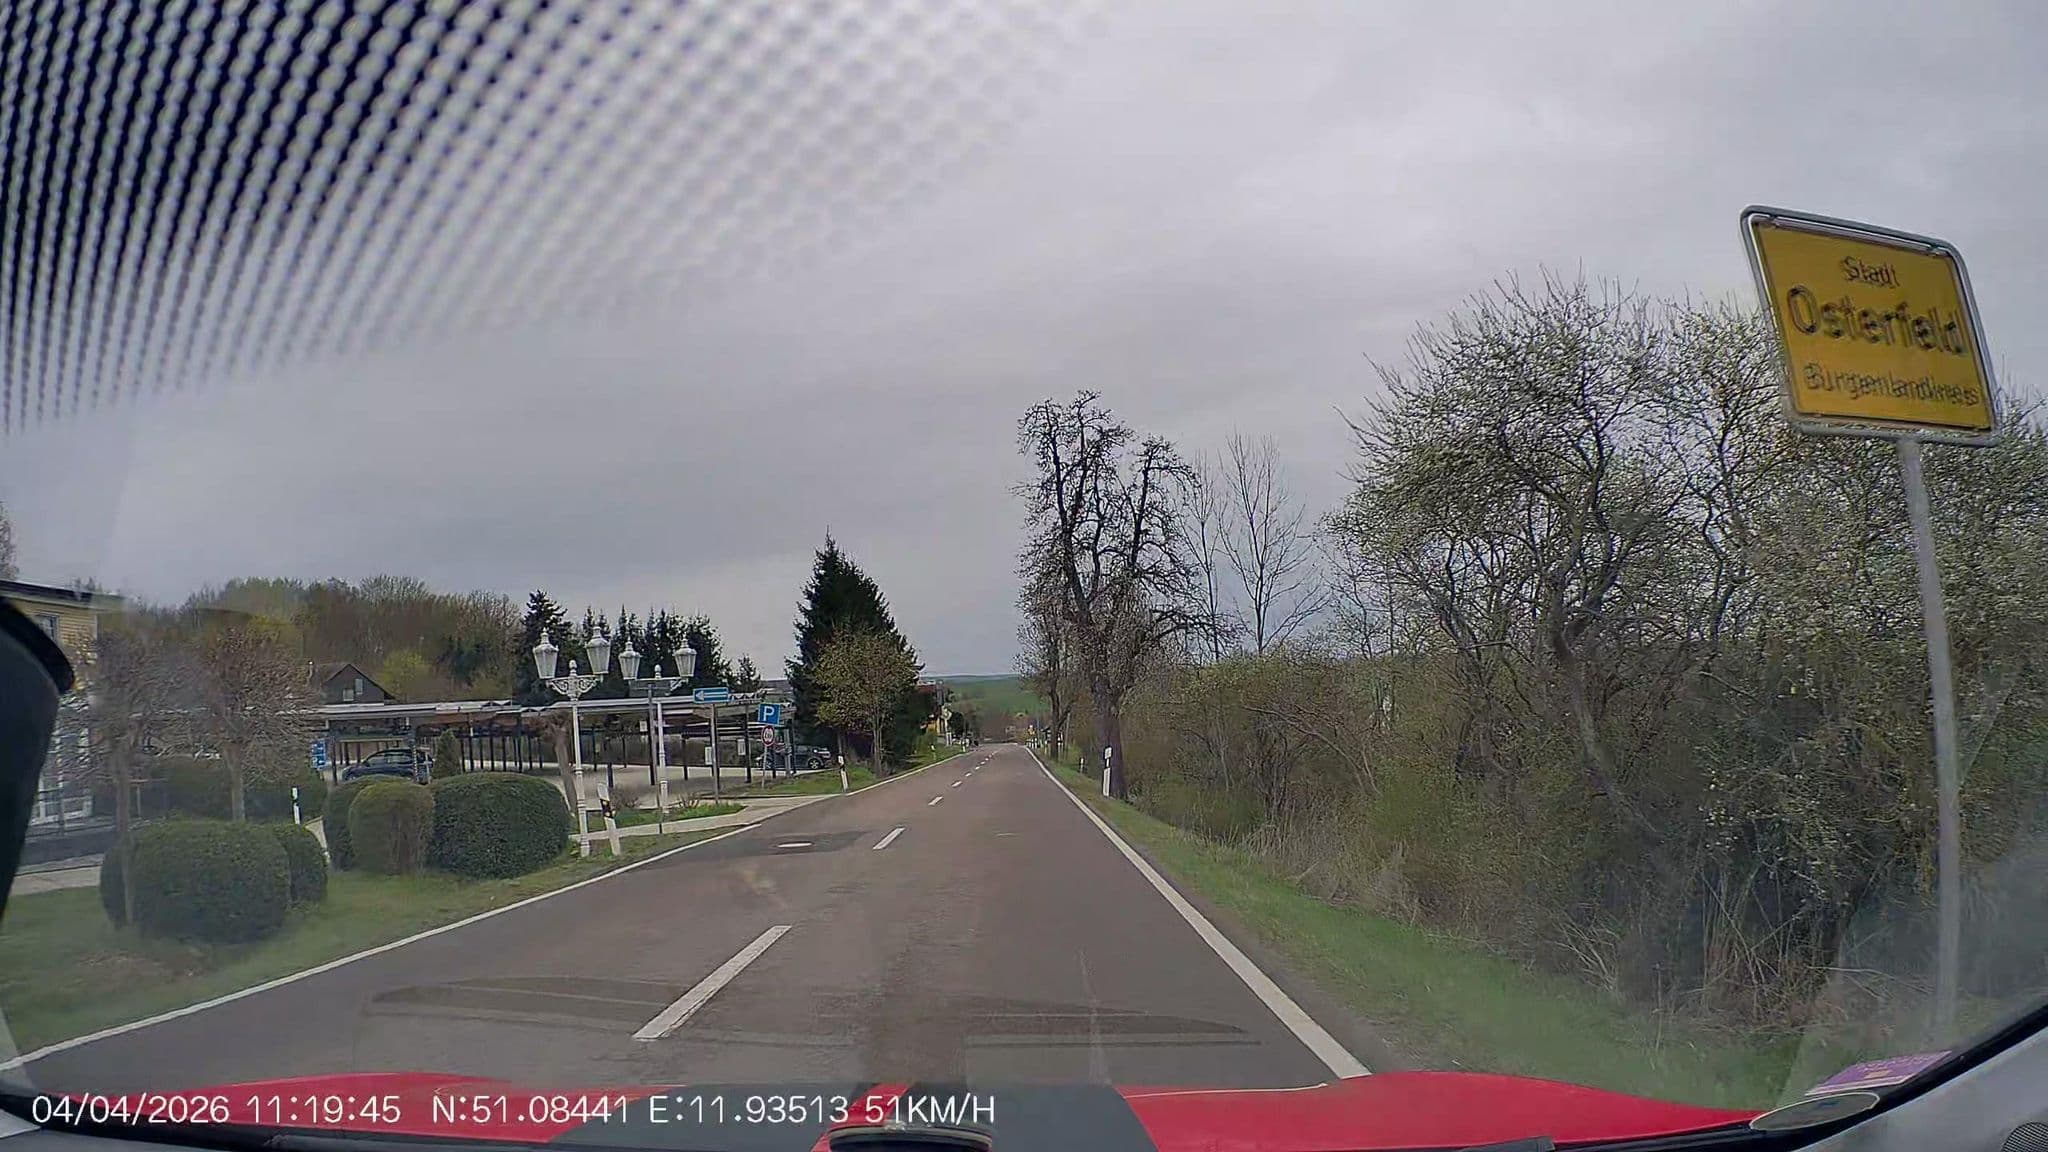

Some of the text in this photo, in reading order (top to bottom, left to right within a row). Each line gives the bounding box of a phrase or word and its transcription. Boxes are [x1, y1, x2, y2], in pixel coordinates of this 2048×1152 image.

[1843, 255, 1900, 289] Stadt
[1787, 285, 1969, 354] Osterfeld
[763, 705, 775, 721] P
